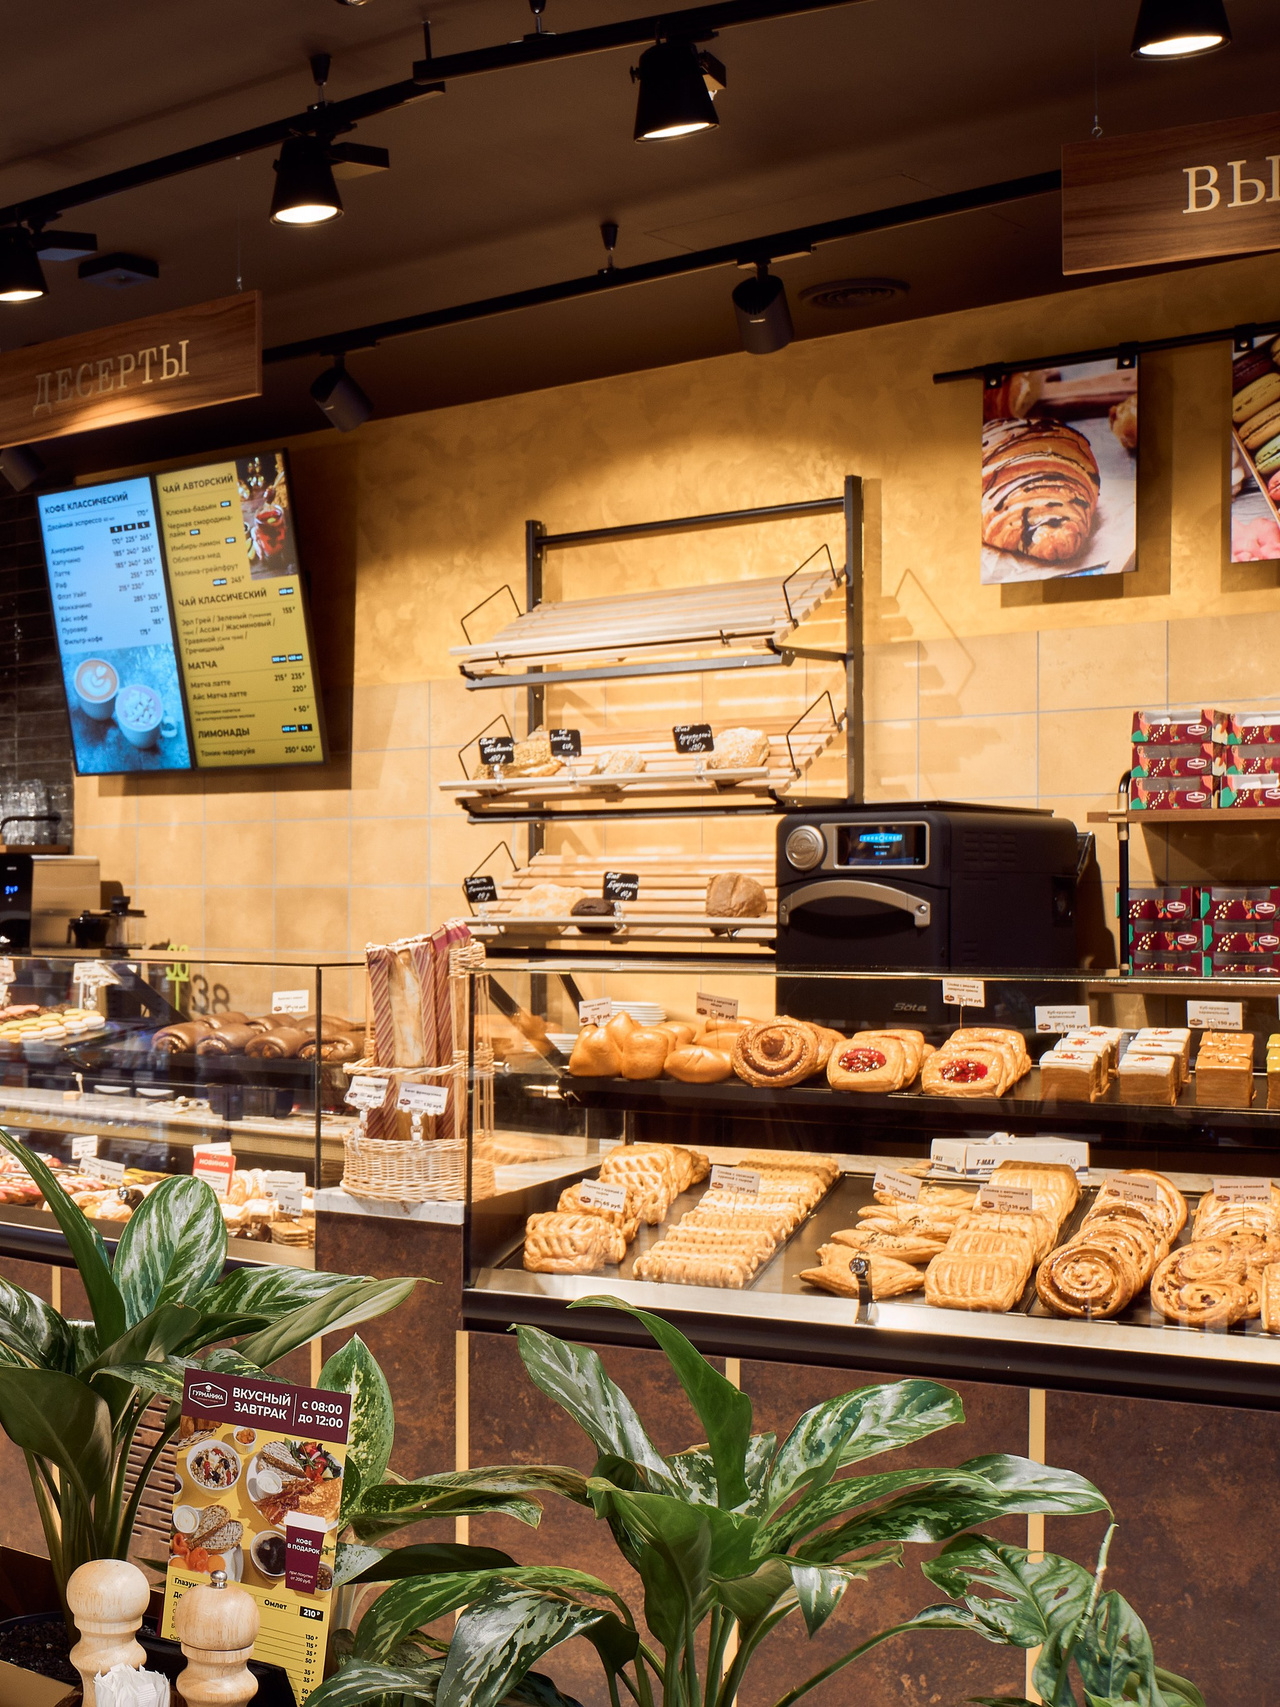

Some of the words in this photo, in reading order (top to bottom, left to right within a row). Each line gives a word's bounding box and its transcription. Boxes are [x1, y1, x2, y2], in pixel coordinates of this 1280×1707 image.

[32, 340, 190, 418] ДЕСЕРТЫ
[162, 483, 180, 494] ЧАЙ
[182, 473, 234, 491] АВТОРСКИЙ
[45, 504, 66, 514] КОФЕ
[67, 491, 129, 510] КЛАССИЧЕСКИЙ
[166, 503, 217, 516] Клюква-бадьян
[168, 521, 192, 531] Черная
[169, 530, 186, 538] лайм
[50, 545, 84, 555] Американо
[171, 540, 220, 552] Имбирь-лимон
[52, 557, 81, 567] Капучино
[172, 552, 221, 564] Облепиха-мед
[174, 563, 238, 577] Малина-грейпфрут
[178, 597, 196, 607] ЧАЙ
[198, 587, 267, 605] КЛАССИЧЕСКИЙ
[195, 617, 211, 625] Грей
[217, 613, 247, 622] Зеленый
[225, 620, 271, 630] Жасминовый
[64, 636, 103, 645] Фильтр-кофе
[185, 645, 225, 655] Гречишный
[188, 660, 218, 670] МАТЧА
[198, 727, 250, 738] ЛИМОНАДЫ
[201, 748, 255, 757] Тоник-маракуйя
[199, 1158, 229, 1168] НОВИНКА
[192, 1389, 224, 1401] ГУРМАНИКА
[232, 1387, 292, 1407] ВКУСНЫЙ
[301, 1401, 309, 1409] с
[310, 1400, 343, 1415] 08:00
[233, 1401, 287, 1420] ЗАВТРАК
[297, 1414, 313, 1424] до
[315, 1414, 344, 1429] 12:00
[296, 1537, 312, 1546] КОФЕ
[292, 1544, 320, 1555] ПОДАРОК
[264, 1599, 288, 1610] Омлет
